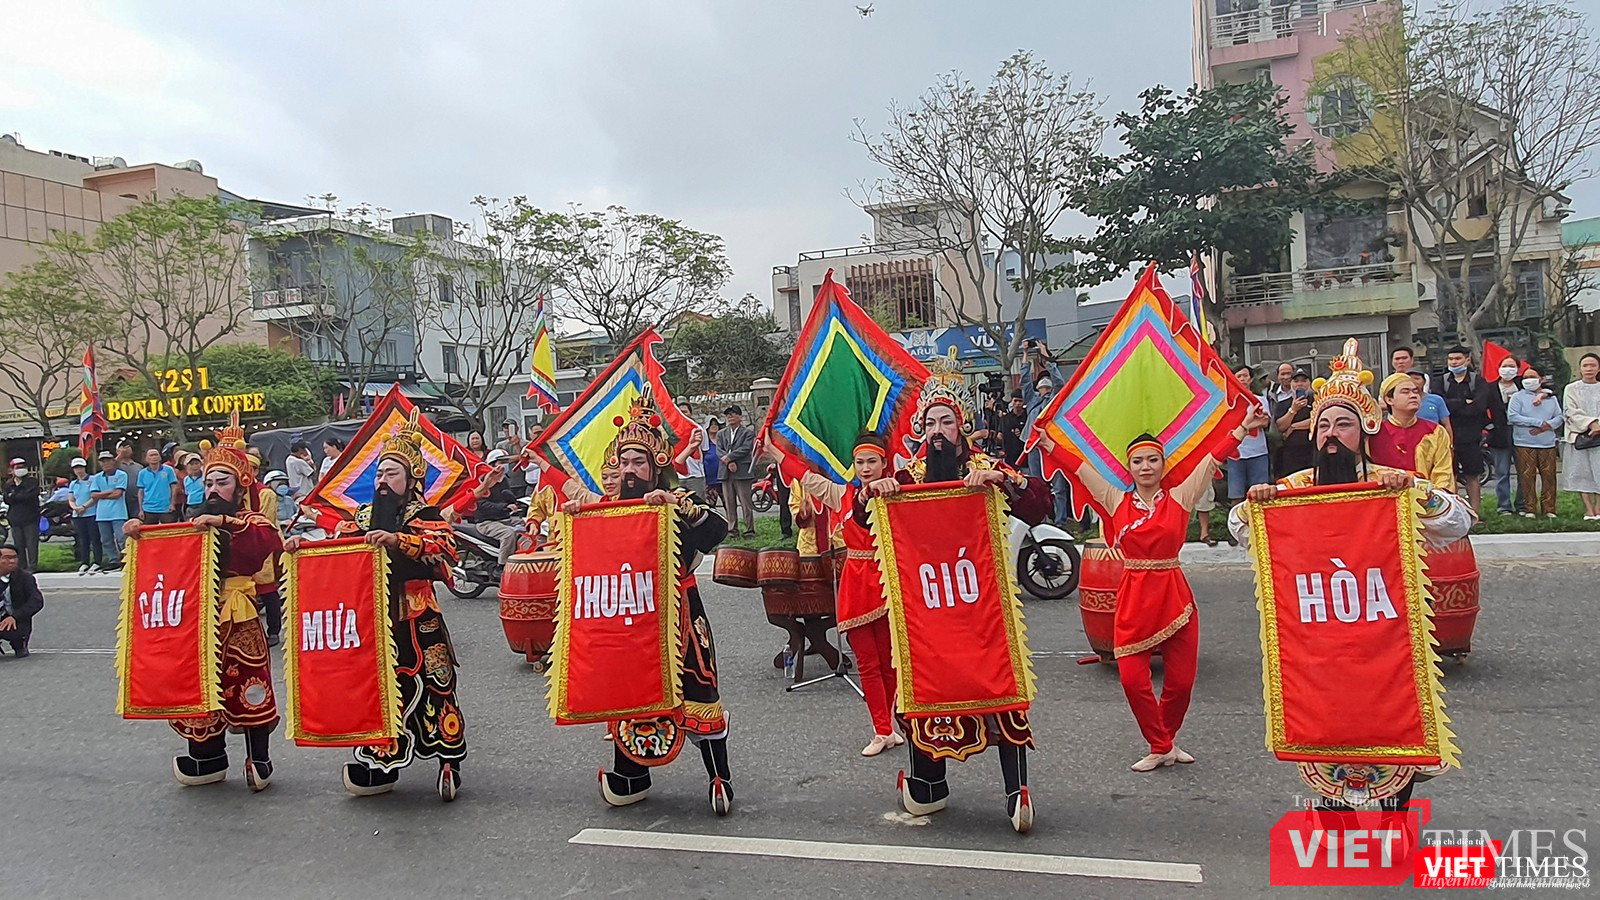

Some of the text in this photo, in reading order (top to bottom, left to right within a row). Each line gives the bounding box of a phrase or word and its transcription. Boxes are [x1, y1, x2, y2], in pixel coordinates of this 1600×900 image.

[107, 393, 266, 421] BONJOUR COFFEE
[138, 573, 186, 630] CẦU
[574, 562, 656, 626] THUẬN
[919, 546, 980, 609] GIÓ
[1295, 557, 1399, 623] HÒA
[302, 602, 361, 651] MƯA
